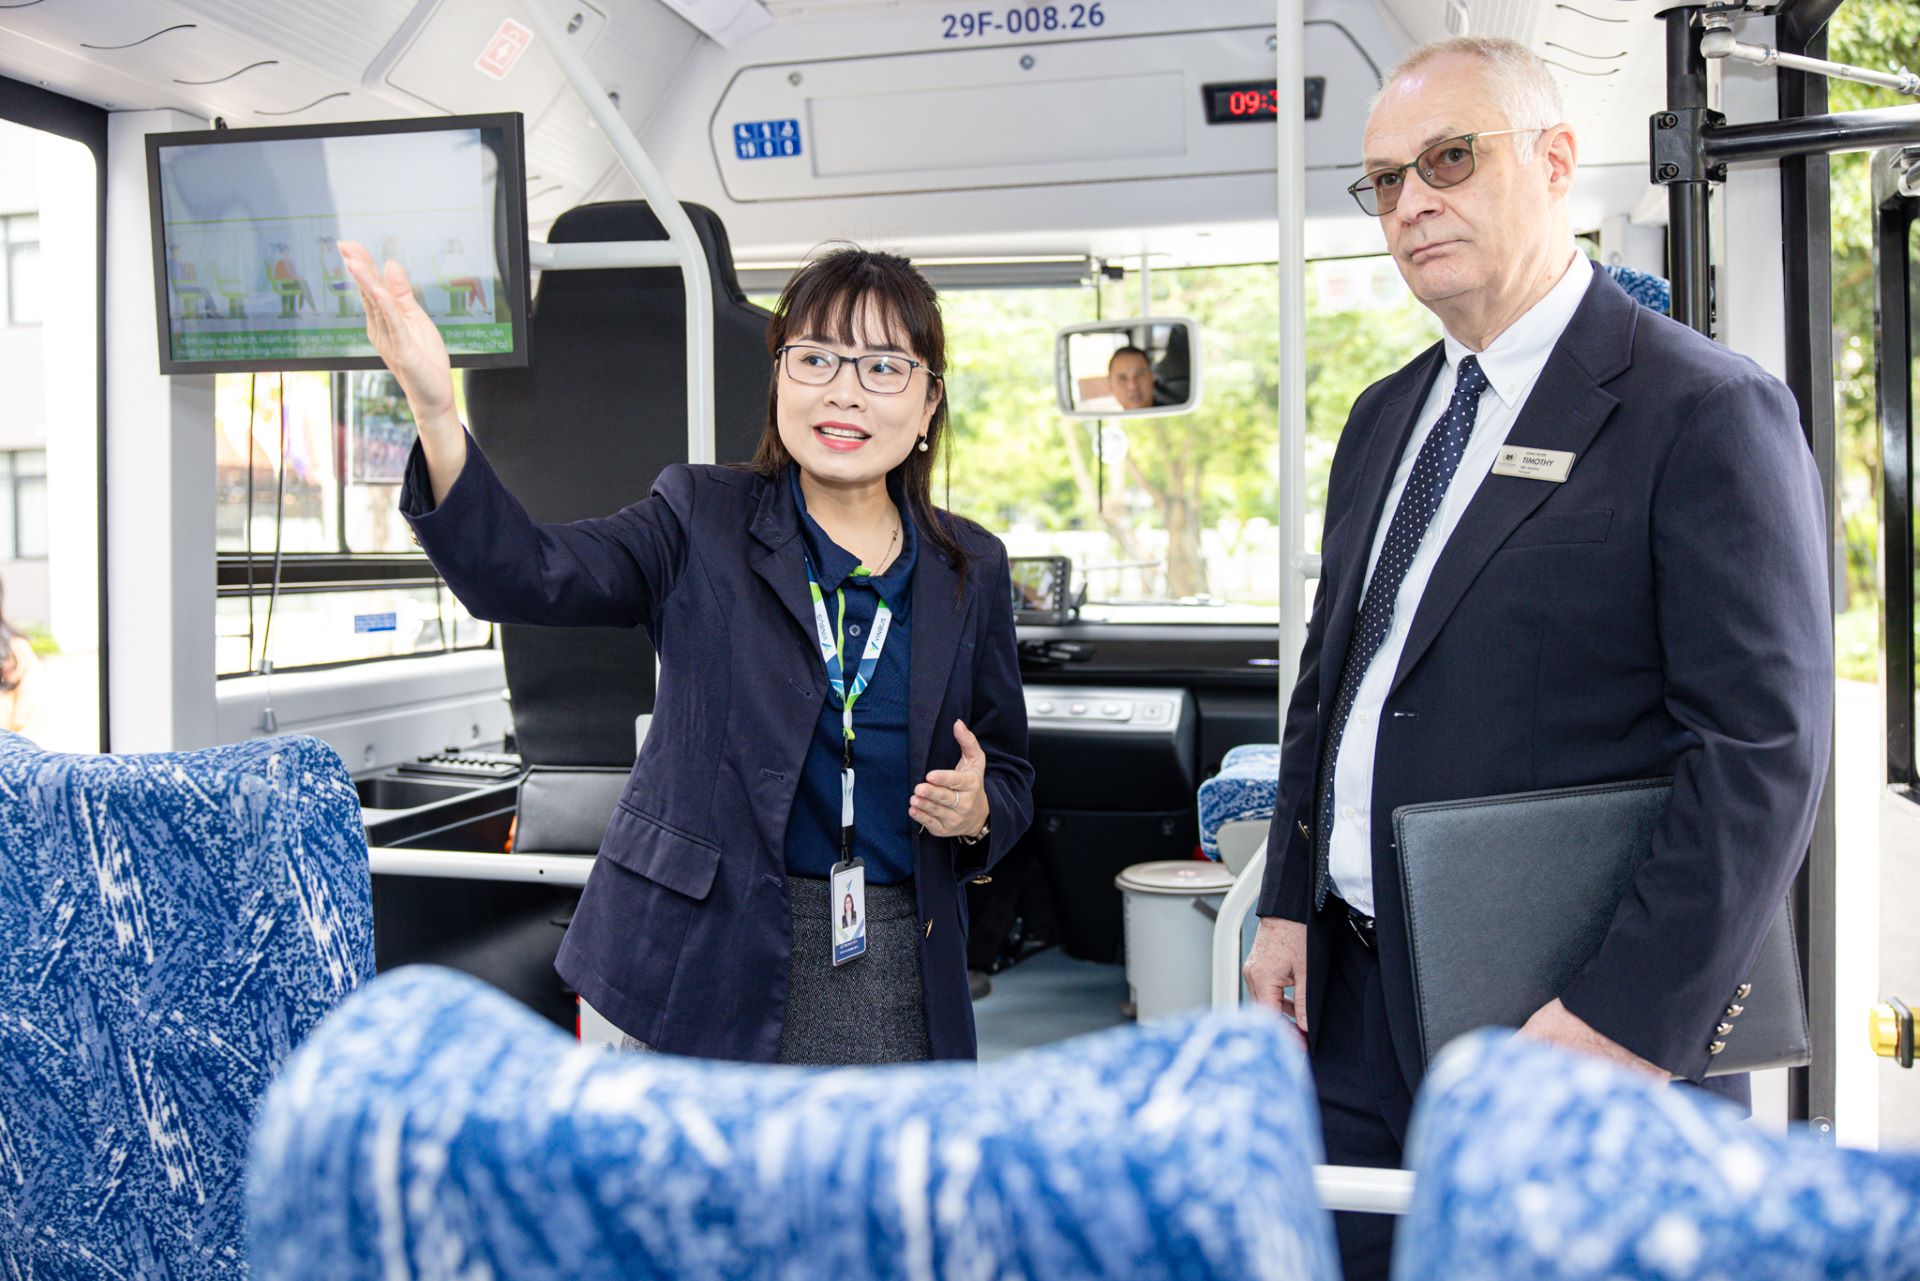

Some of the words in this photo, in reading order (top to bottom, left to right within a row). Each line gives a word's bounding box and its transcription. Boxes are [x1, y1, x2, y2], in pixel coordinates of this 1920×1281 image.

[942, 3, 1105, 38] 29F-008.26
[1522, 456, 1554, 467] TIMOTHY
[816, 613, 829, 642] VINBUS
